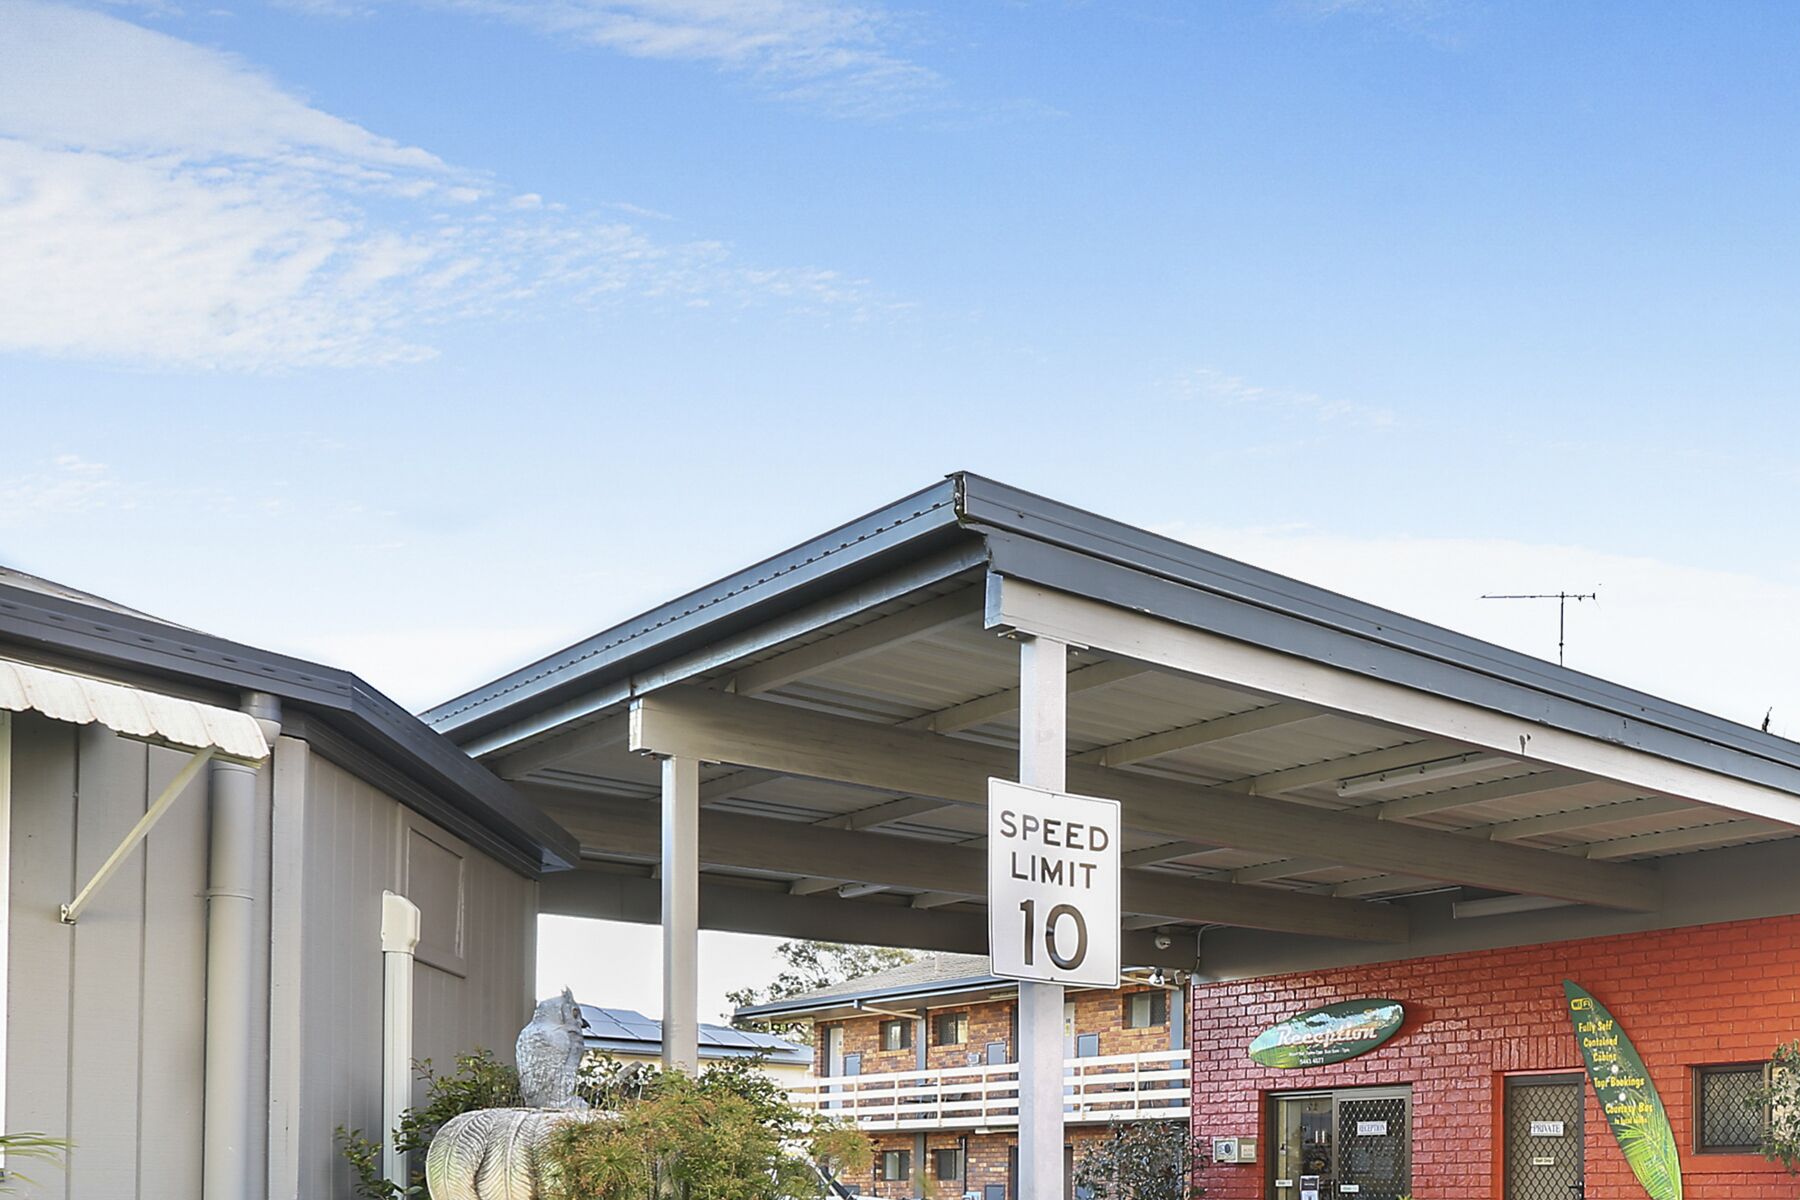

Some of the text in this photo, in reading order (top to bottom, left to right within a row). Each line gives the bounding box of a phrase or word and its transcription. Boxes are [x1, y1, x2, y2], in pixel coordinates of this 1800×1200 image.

[1000, 810, 1109, 852] SPEED
[1011, 852, 1097, 889] LIMIT
[1019, 899, 1088, 971] 10
[1578, 1019, 1613, 1034] Fully Self
[1276, 1022, 1378, 1049] Reception
[1583, 1034, 1618, 1047] Contained
[1593, 1051, 1617, 1062] Cabins
[1610, 1075, 1645, 1089] Bookings
[1533, 1124, 1561, 1133] PRIVATE
